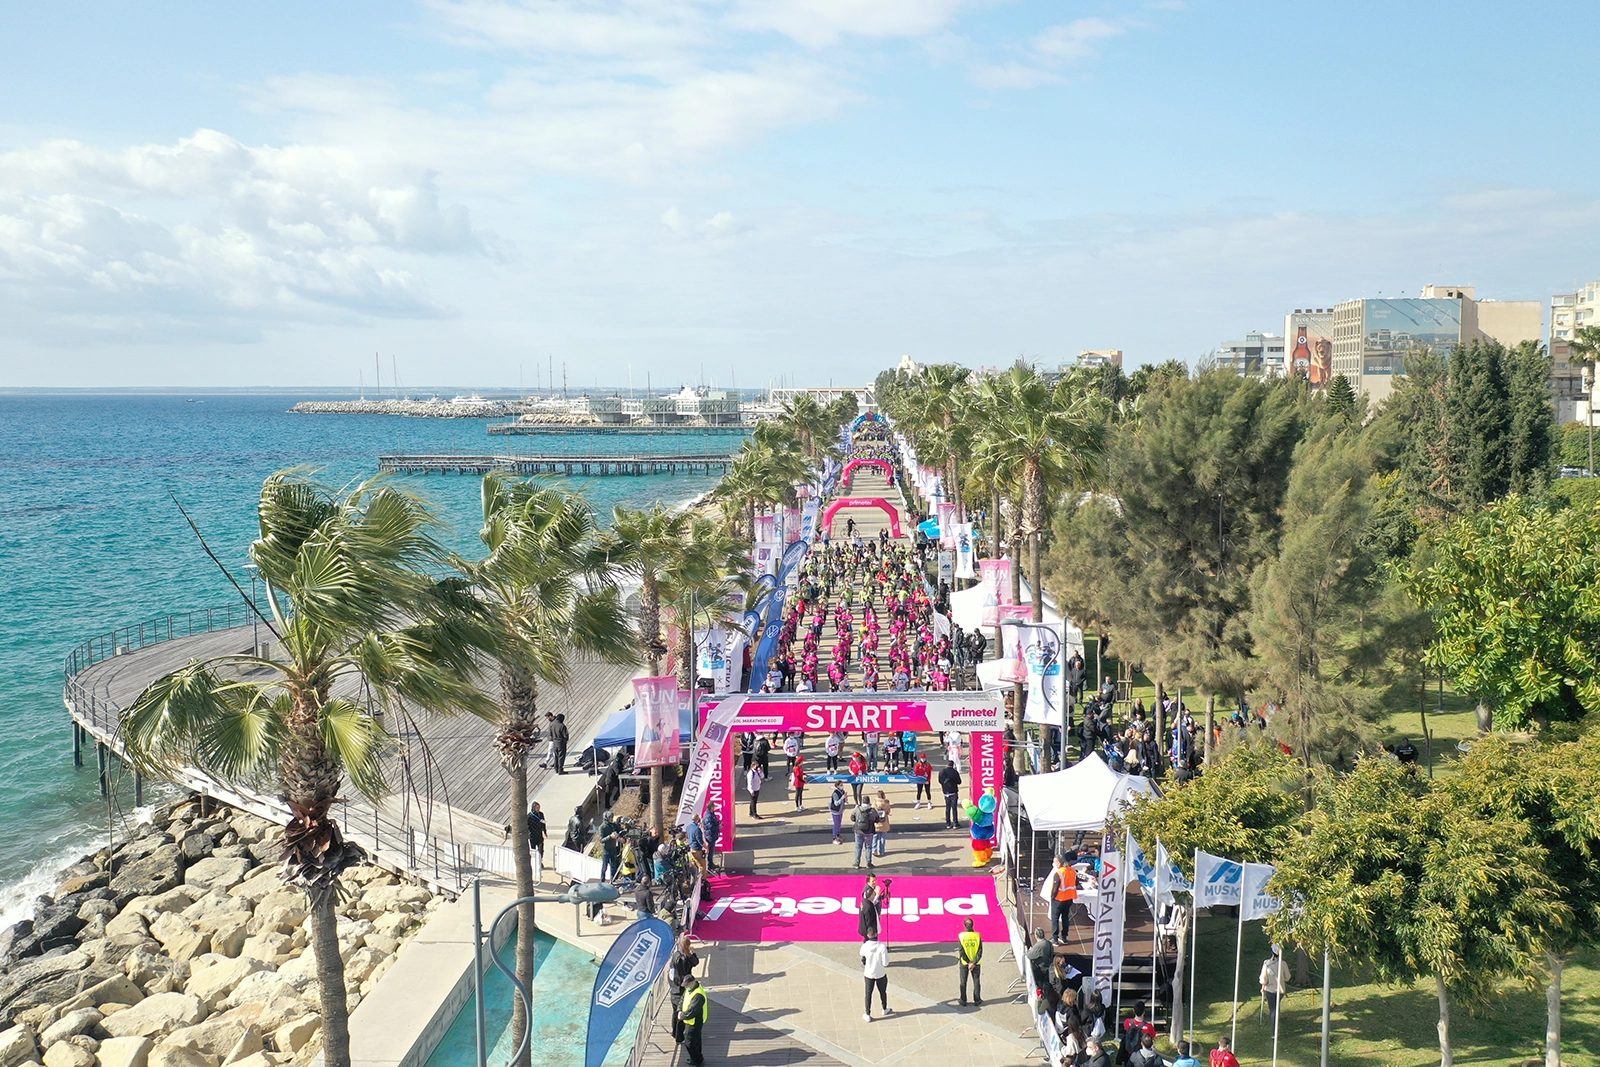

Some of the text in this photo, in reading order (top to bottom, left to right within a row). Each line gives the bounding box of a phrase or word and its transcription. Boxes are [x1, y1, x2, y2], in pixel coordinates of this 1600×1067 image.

[984, 569, 1008, 580] RUN
[640, 689, 675, 705] RUN
[806, 705, 898, 729] START
[951, 707, 997, 718] primetel
[681, 741, 711, 815] ASFALISTIKI
[702, 893, 990, 923] primetel
[1095, 861, 1117, 992] ASFALISTIKI
[601, 936, 653, 1000] PETROLINA
